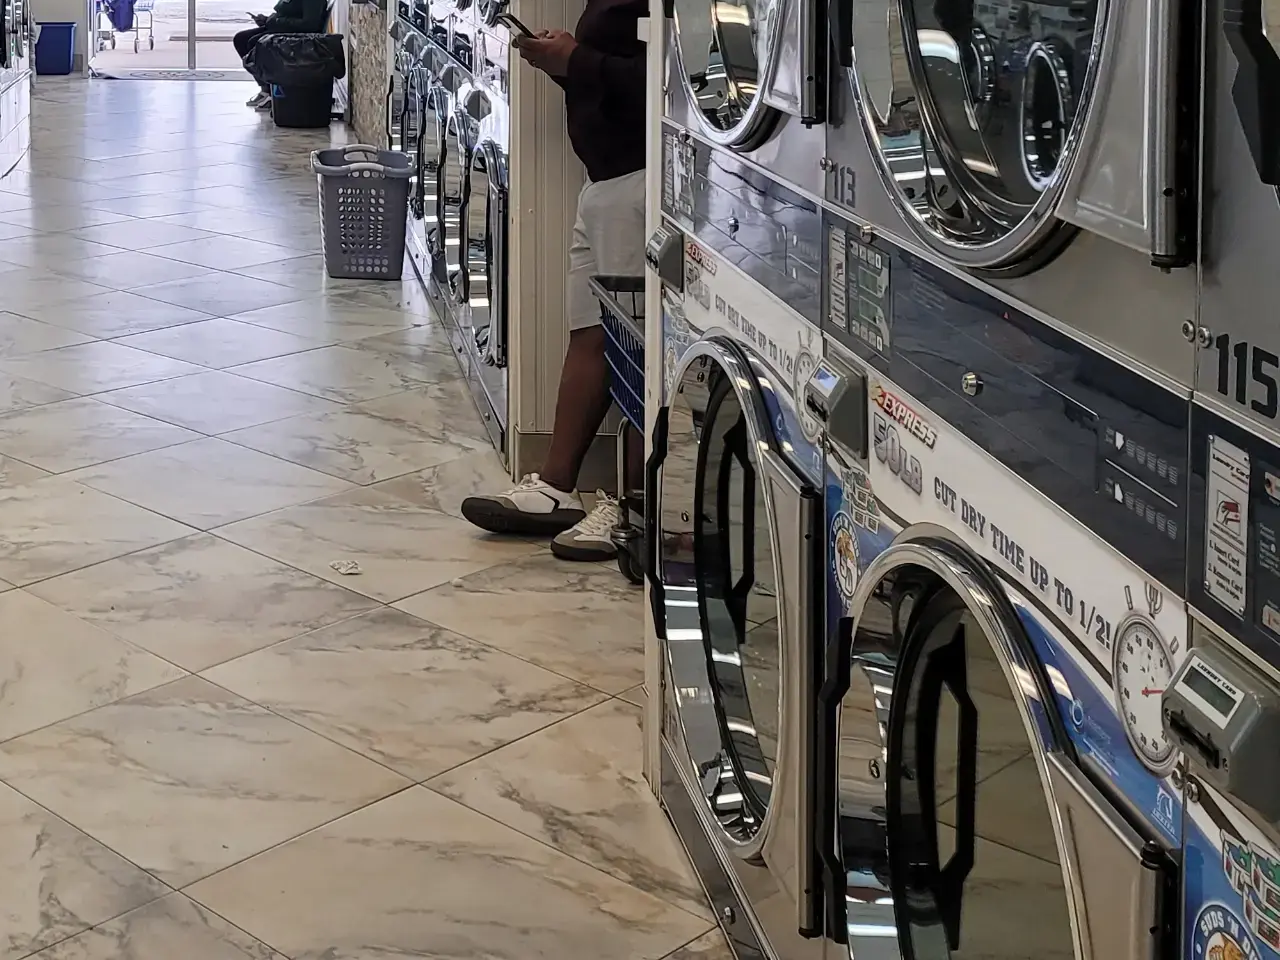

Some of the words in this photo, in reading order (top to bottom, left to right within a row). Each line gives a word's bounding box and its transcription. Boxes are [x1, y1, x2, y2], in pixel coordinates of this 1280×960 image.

[833, 162, 856, 208] 113
[692, 245, 717, 276] EXPRESS
[715, 294, 726, 316] CUT
[728, 305, 740, 328] DRY
[741, 315, 757, 343] TIME
[758, 330, 767, 350] UP
[768, 339, 777, 361] TO
[779, 348, 793, 375] 1/2!
[1216, 334, 1278, 419] 115
[882, 395, 938, 449] EXPRESS
[1212, 453, 1235, 471] Laundry
[873, 412, 922, 495] 50LB
[934, 476, 957, 514] CUT
[960, 495, 987, 539] DRY
[990, 522, 1025, 574] TIME
[1029, 556, 1049, 592] UP
[1053, 580, 1074, 617] TO
[1079, 600, 1112, 651] 1/2!
[1214, 543, 1227, 558] Insert
[1228, 552, 1240, 567] Card
[1213, 566, 1231, 583] Remove
[1231, 578, 1243, 594] Card
[1152, 808, 1176, 835] DEXTER
[1201, 911, 1225, 937] SUDS
